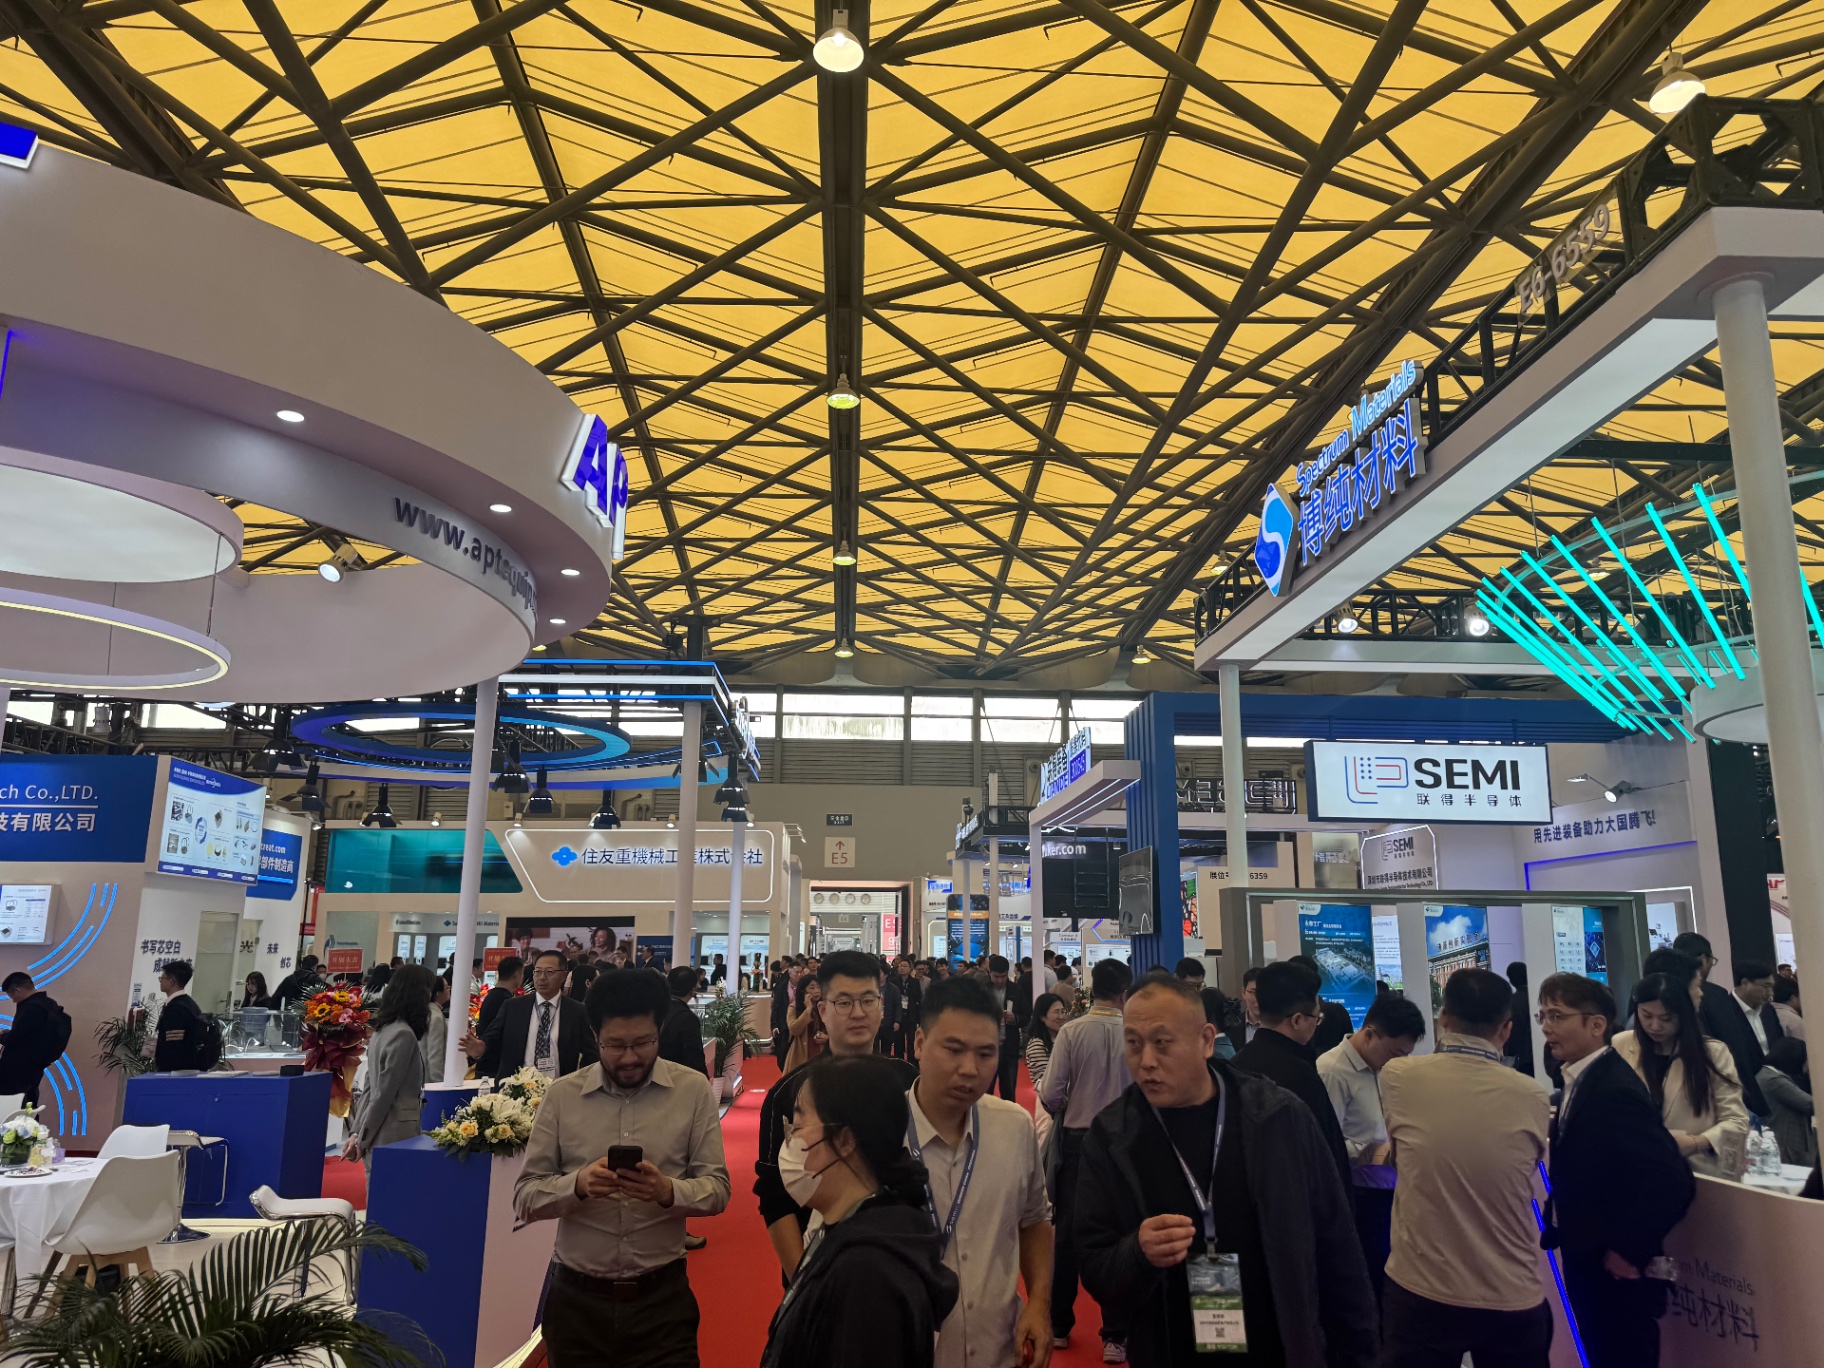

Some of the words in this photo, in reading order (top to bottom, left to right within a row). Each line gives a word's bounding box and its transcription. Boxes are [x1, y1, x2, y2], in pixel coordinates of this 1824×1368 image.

[1296, 428, 1350, 496] Spectrum
[1351, 360, 1416, 441] Materials
[1298, 400, 1418, 566] 博纯材料
[1414, 758, 1520, 790] SEMI
[25, 785, 98, 802] Co.,LTD.
[1416, 793, 1521, 807] 联得半导体
[1534, 810, 1656, 843] 用先进装备助力大国腾飞!
[1393, 837, 1414, 852] SEMI
[259, 855, 294, 874] 部件制造商
[581, 847, 763, 865] 住友重機械工株式社
[831, 852, 848, 865] E5
[1249, 872, 1268, 880] 6359
[140, 939, 182, 955] 书写芯空白
[1695, 1257, 1756, 1296] Materials
